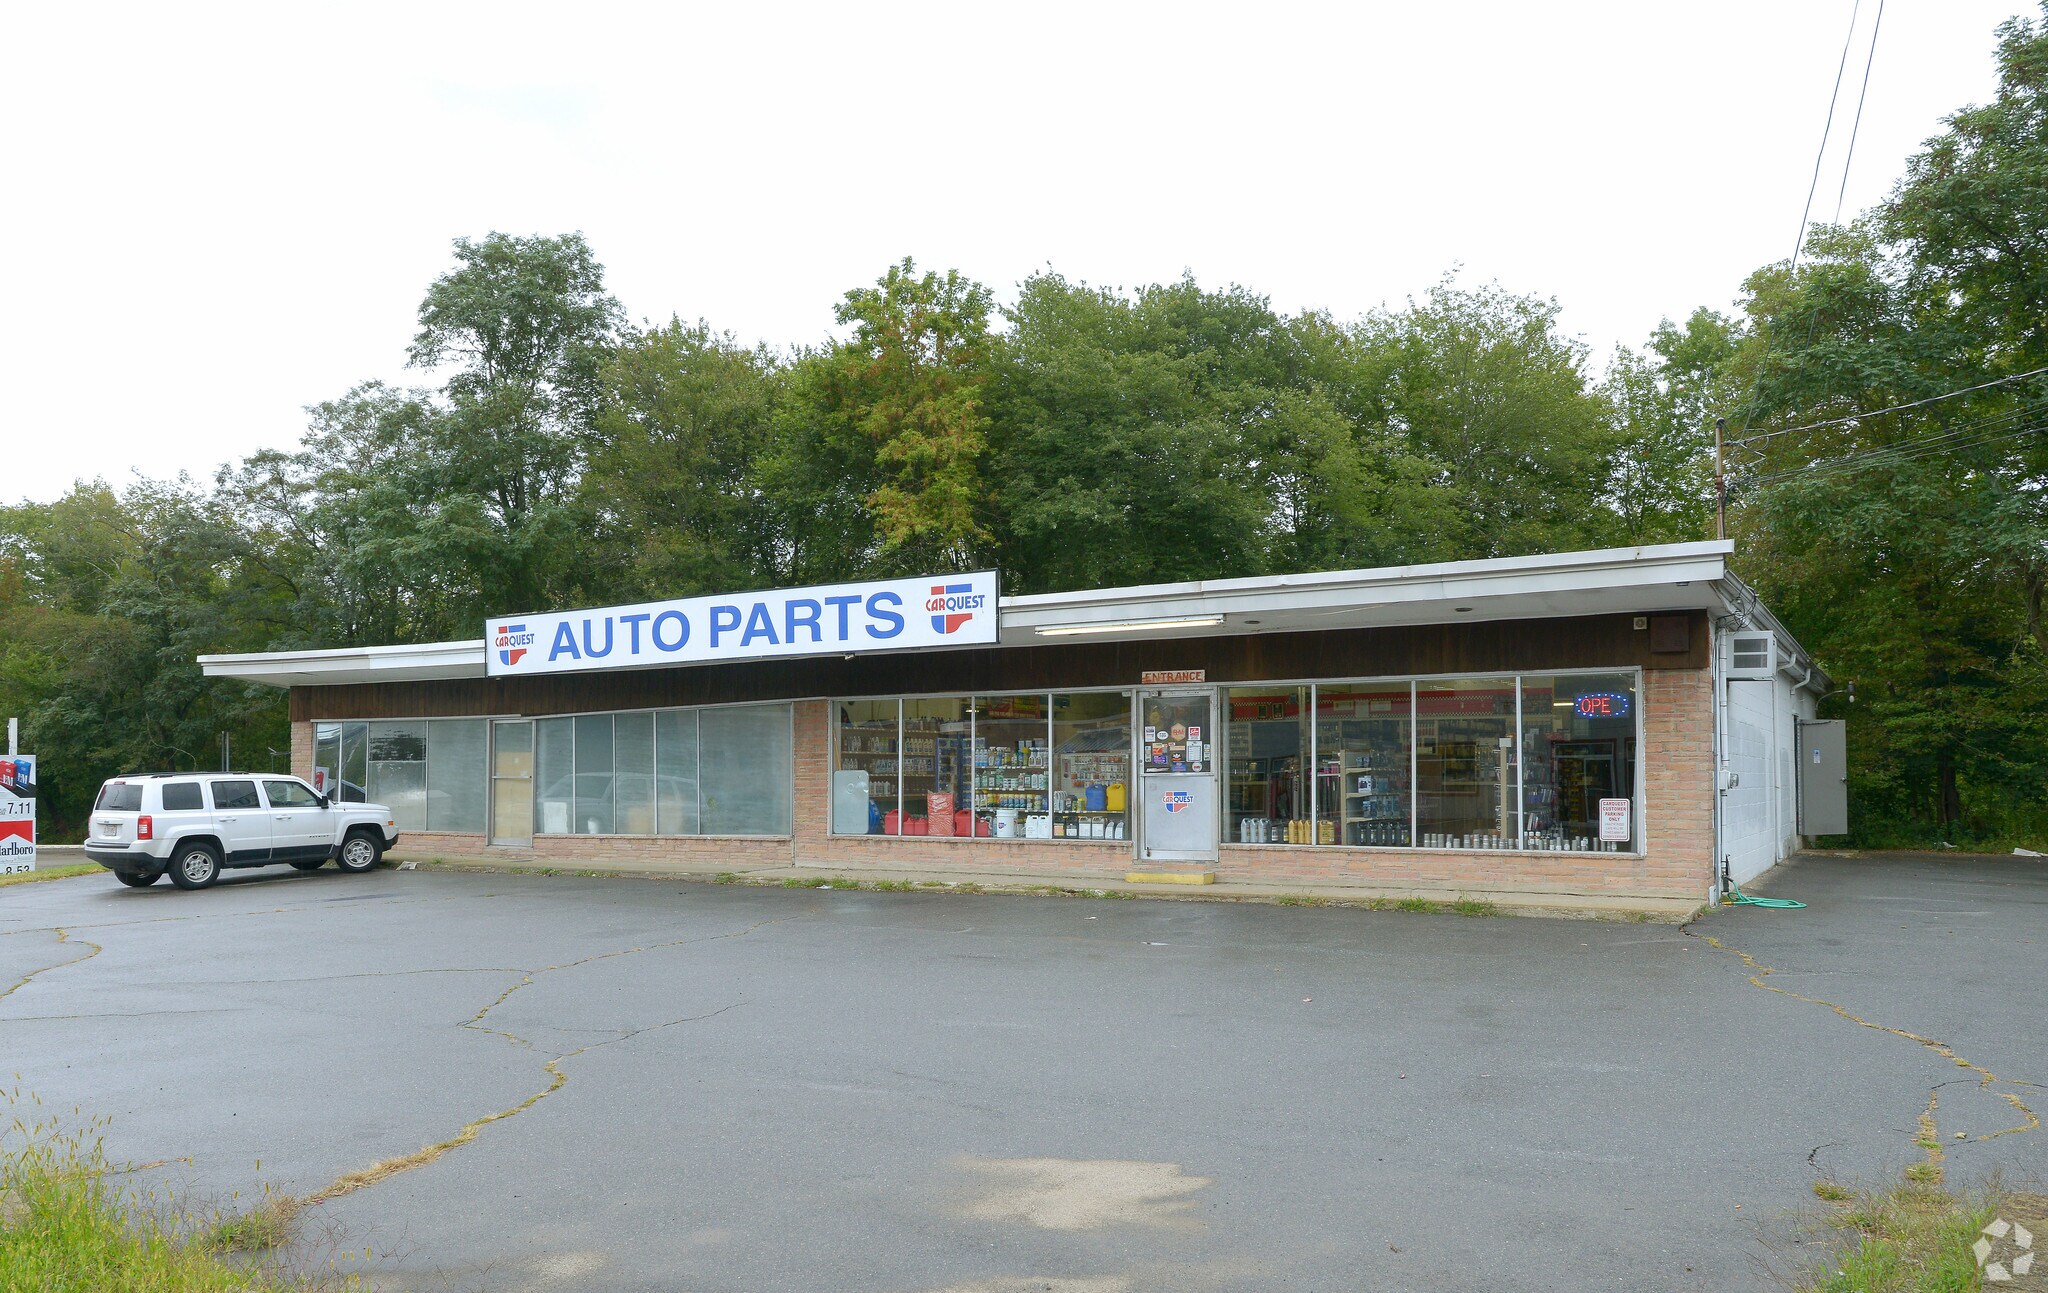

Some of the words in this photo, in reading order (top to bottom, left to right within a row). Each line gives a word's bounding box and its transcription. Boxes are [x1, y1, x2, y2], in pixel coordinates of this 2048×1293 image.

[926, 594, 985, 611] CARQUEST
[548, 610, 690, 661] AUTO
[710, 591, 905, 647] PARTS
[495, 633, 534, 647] CARQUEST
[1143, 671, 1202, 682] ENTRANCE
[7, 802, 30, 814] 7.11
[0, 842, 33, 855] arlboro
